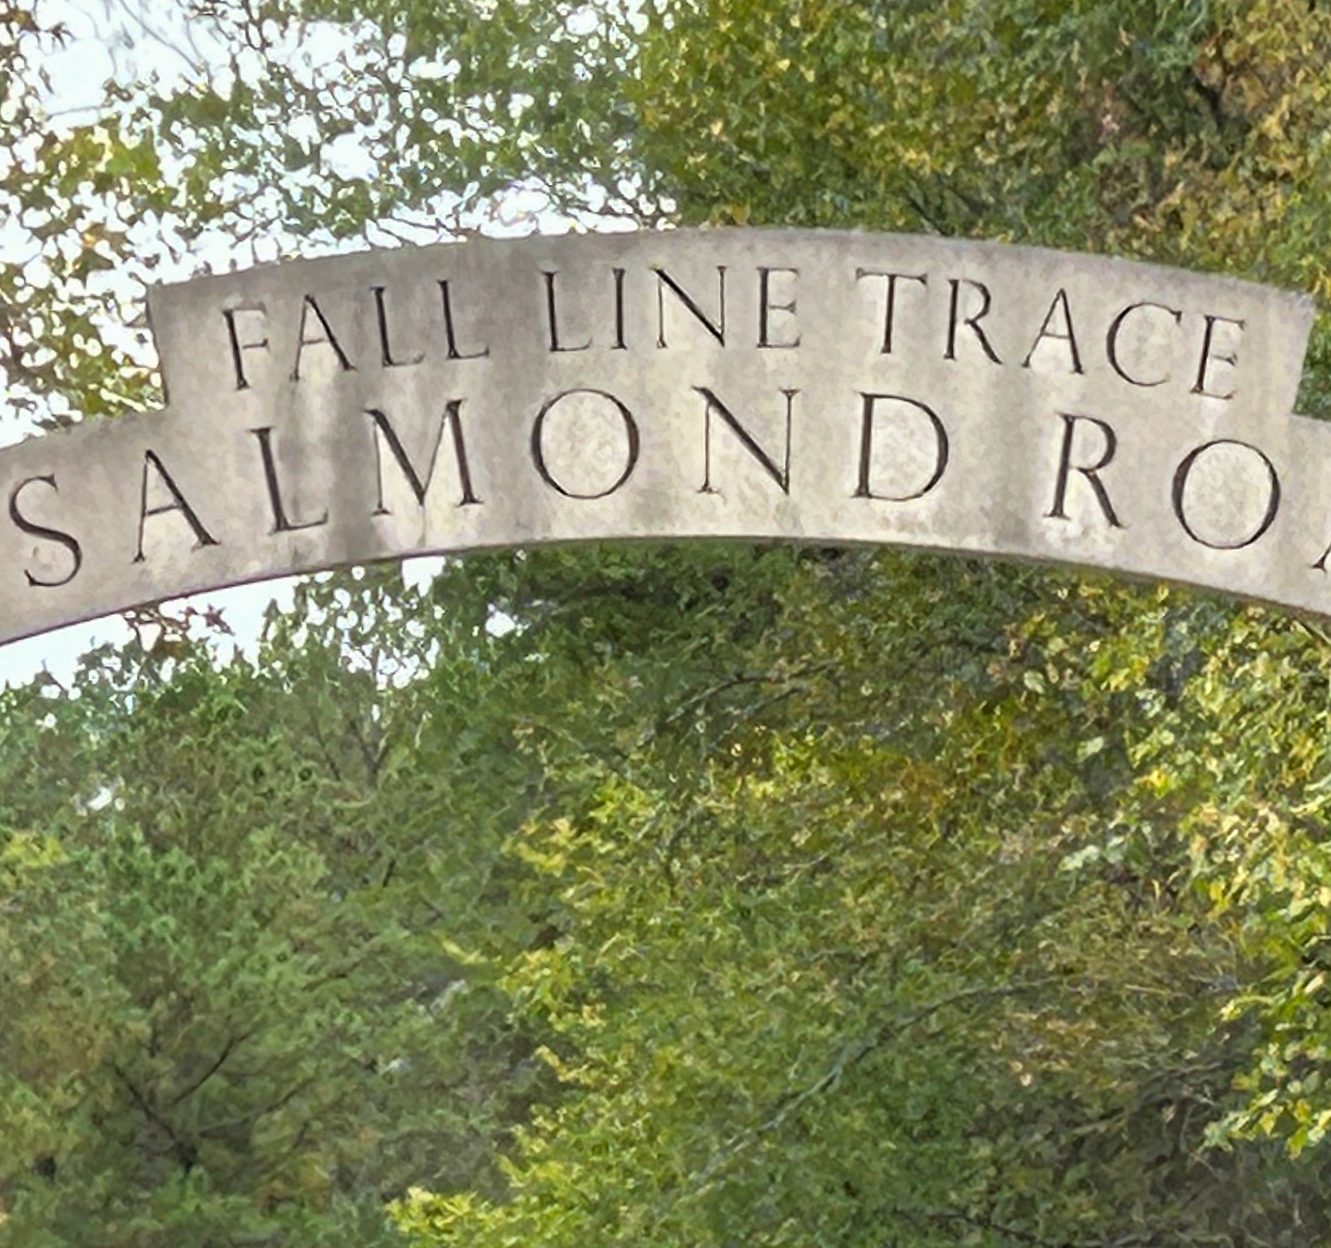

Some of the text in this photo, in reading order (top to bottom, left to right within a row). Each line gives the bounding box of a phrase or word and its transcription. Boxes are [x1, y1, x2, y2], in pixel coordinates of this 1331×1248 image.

[221, 267, 1247, 400] FALL LINE TRACE
